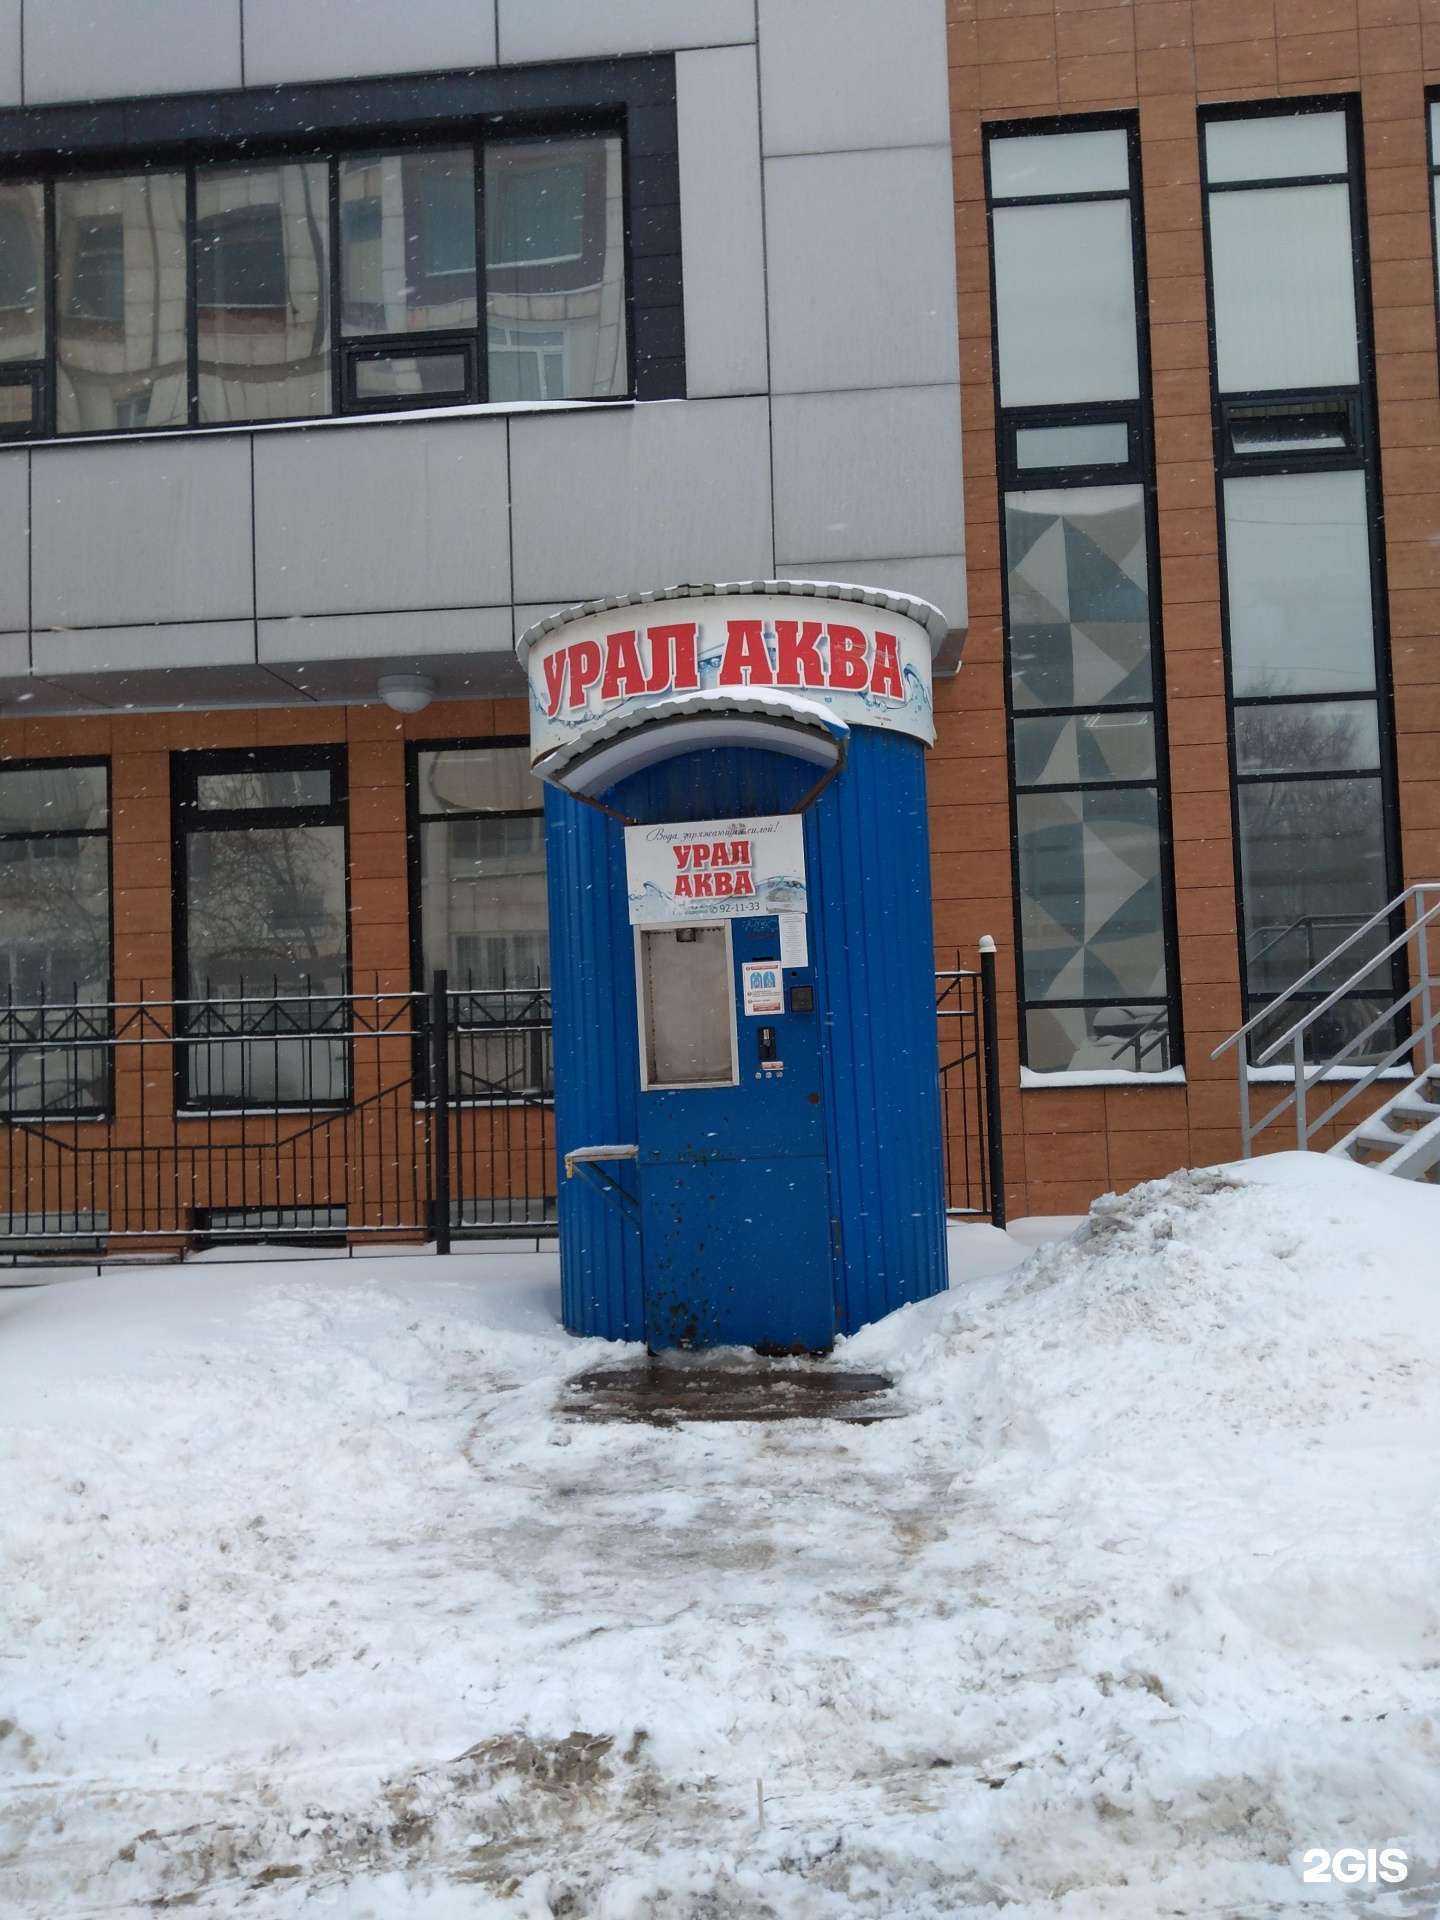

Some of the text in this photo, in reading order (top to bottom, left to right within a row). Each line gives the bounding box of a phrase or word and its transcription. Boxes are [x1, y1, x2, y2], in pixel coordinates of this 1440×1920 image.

[542, 618, 906, 717] УРАЛ АКВА
[672, 840, 751, 870] УРАЛ
[674, 870, 755, 898] АКВА
[719, 901, 760, 913] 92-11-33
